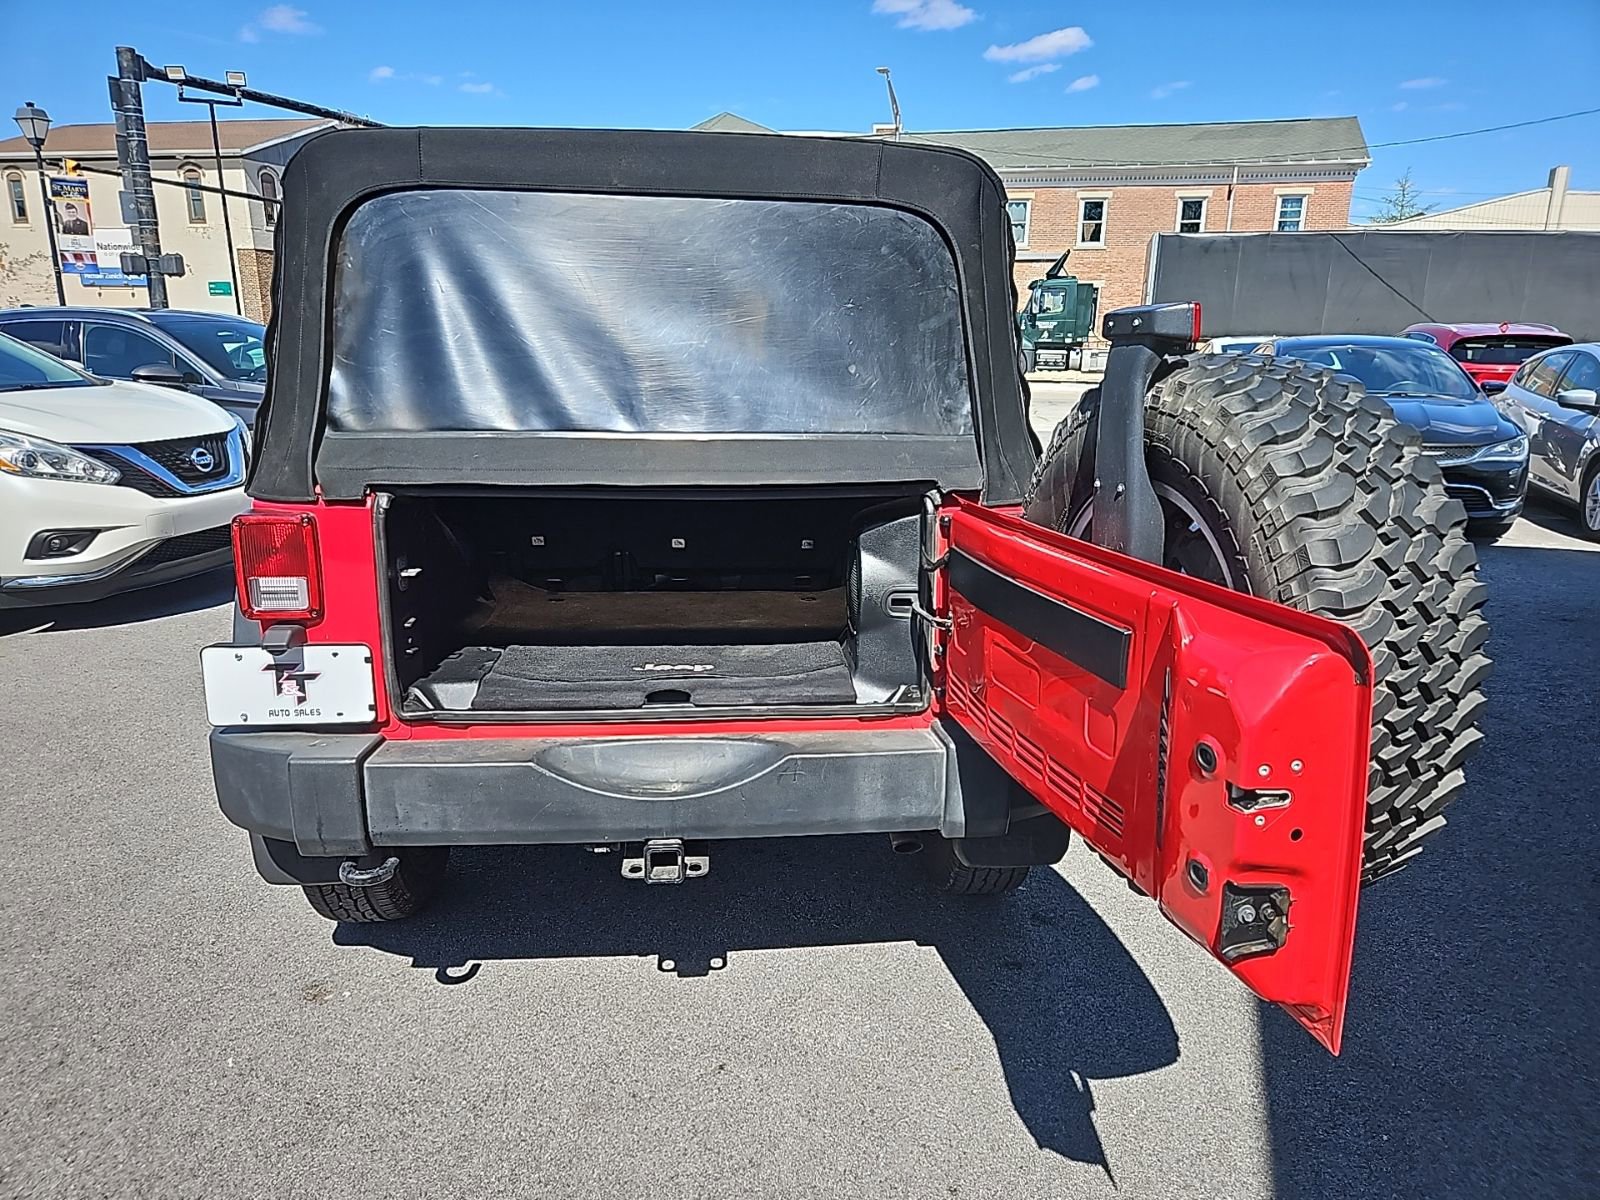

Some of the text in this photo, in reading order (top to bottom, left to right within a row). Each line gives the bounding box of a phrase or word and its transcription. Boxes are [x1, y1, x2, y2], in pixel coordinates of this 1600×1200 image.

[97, 242, 140, 250] Nationwide
[268, 708, 322, 718] AUTO SALES
